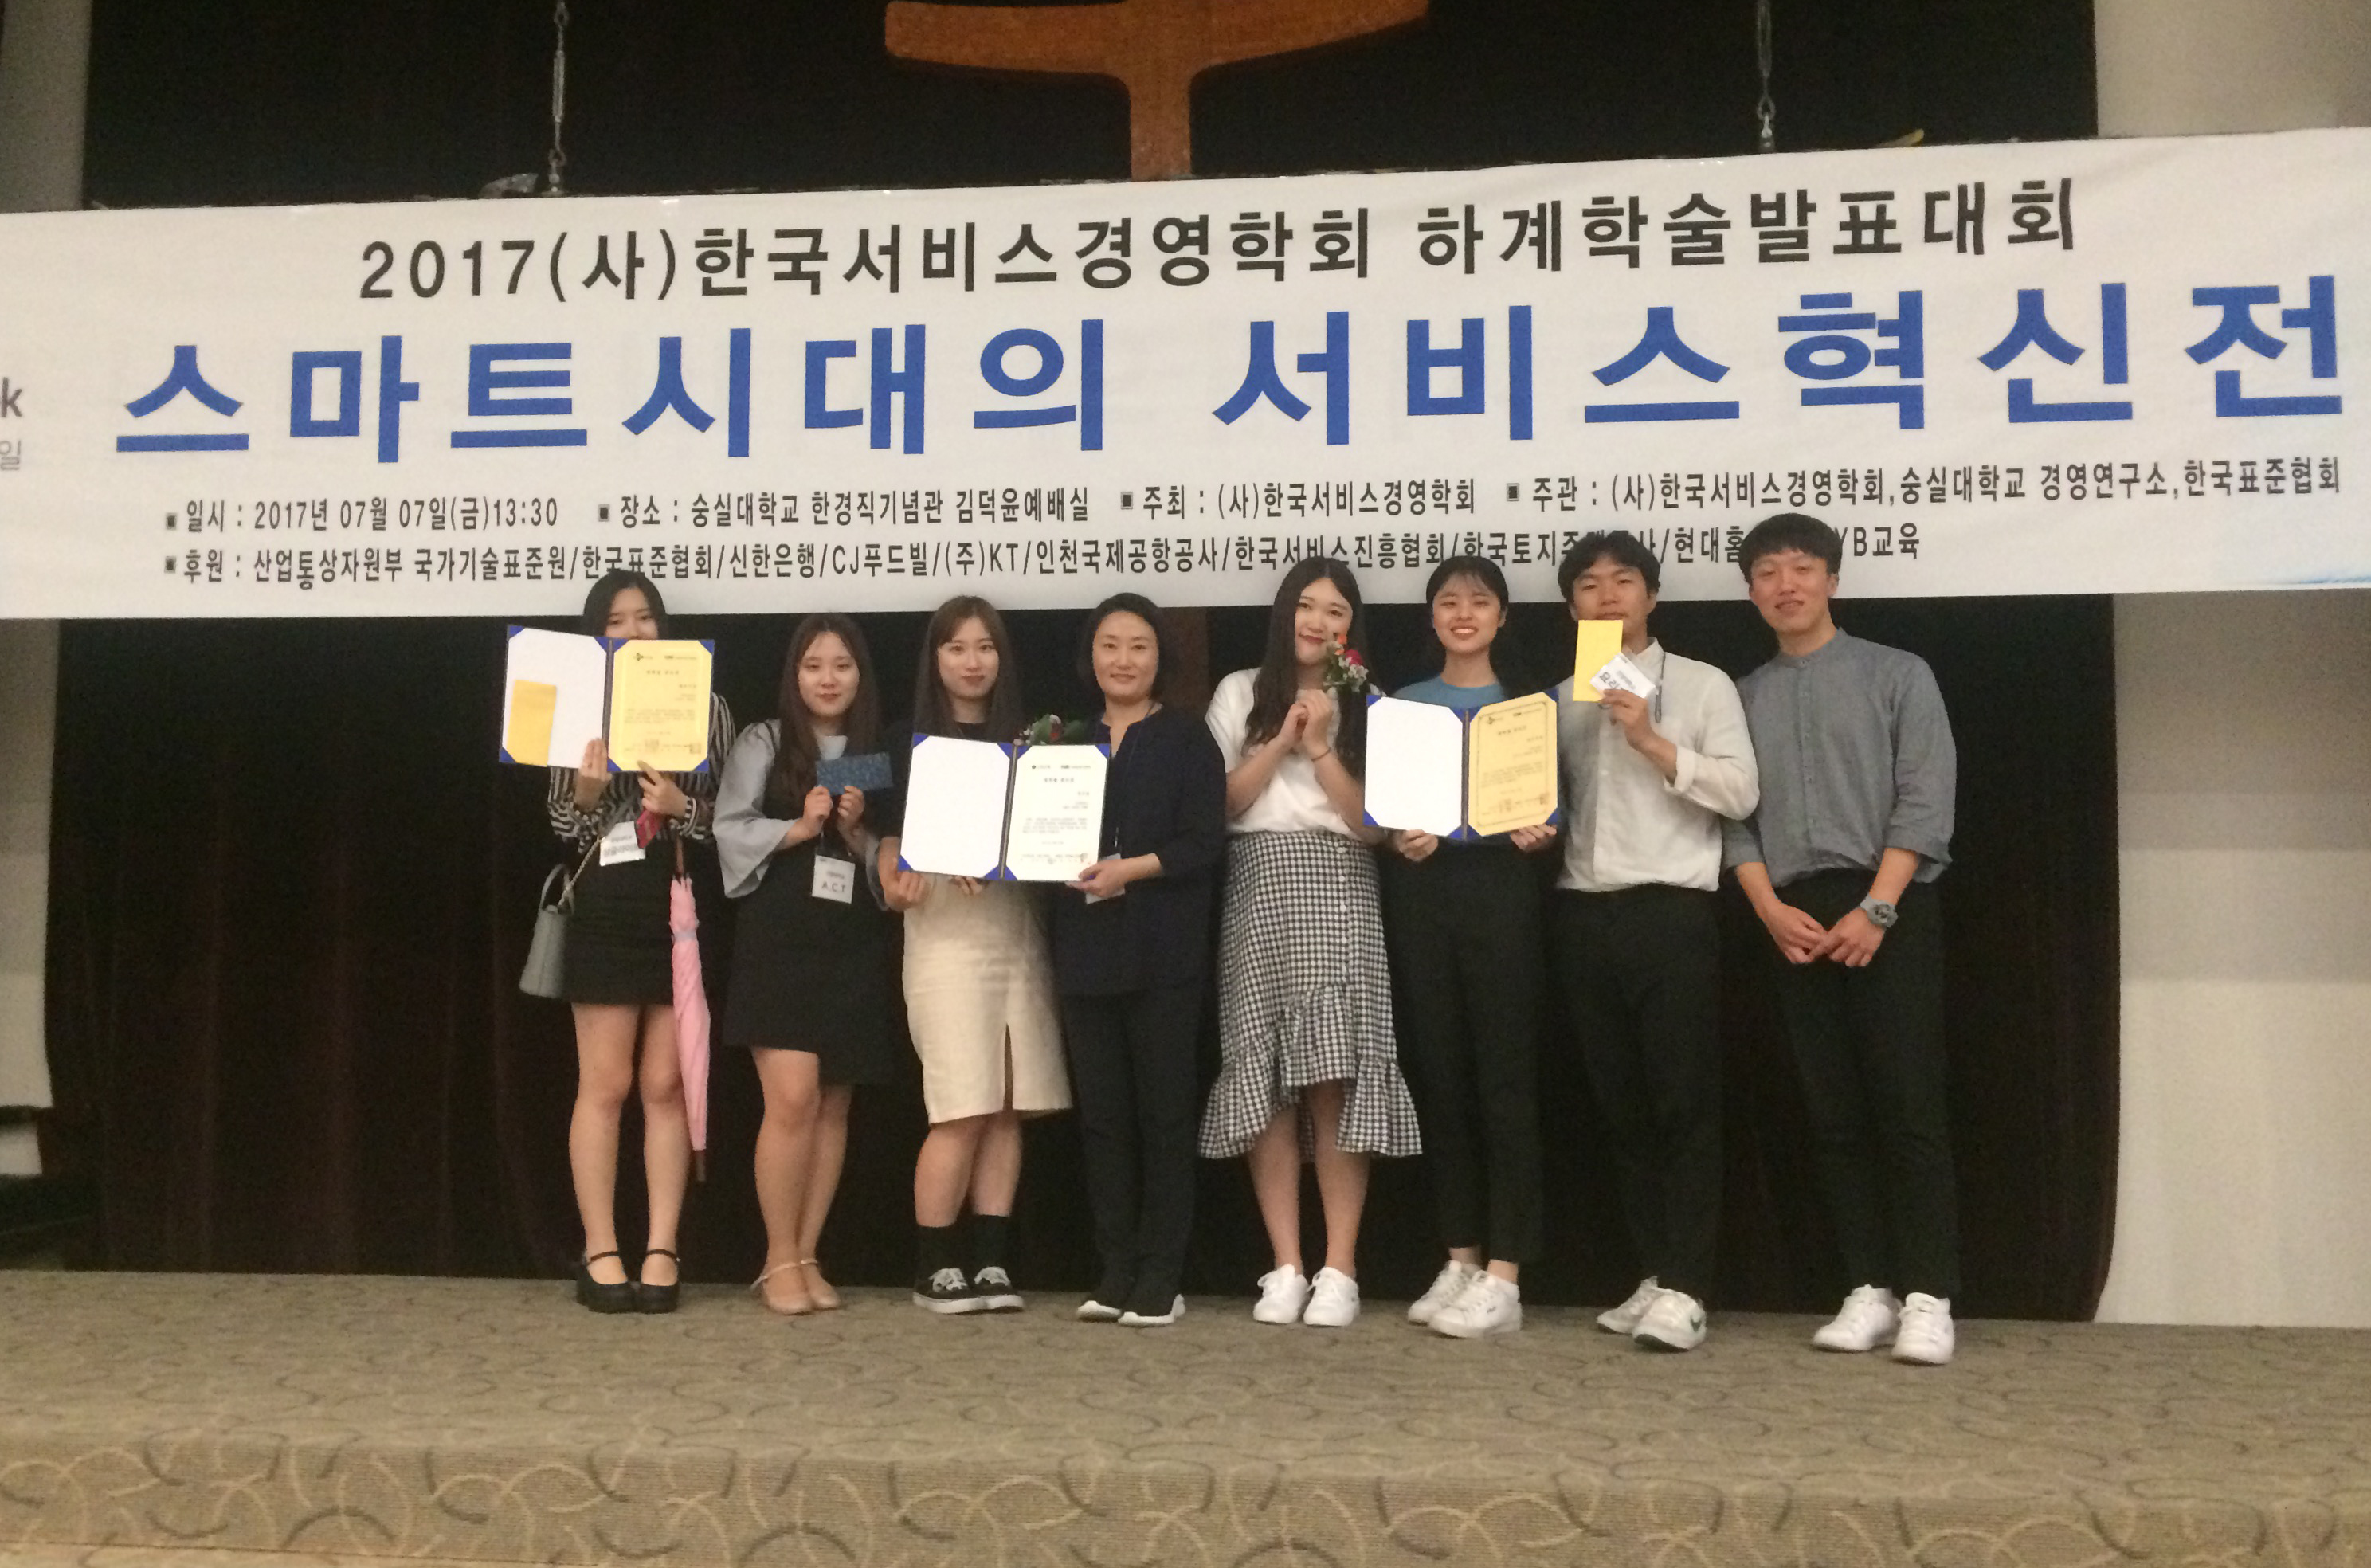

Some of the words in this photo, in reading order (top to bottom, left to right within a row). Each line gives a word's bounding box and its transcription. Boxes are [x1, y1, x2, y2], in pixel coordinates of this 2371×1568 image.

[360, 208, 1368, 303] 2017(사)한국서비스경영학회
[1417, 177, 2074, 275] 하계학술발표대회
[116, 319, 1103, 463] 스마트시대의
[254, 498, 328, 531] 2017년
[339, 496, 387, 531] 07월
[691, 492, 800, 528] 숭실대학교
[811, 489, 943, 526] 한경직기념관
[955, 486, 1088, 523] 김덕윤예배실
[1218, 478, 1475, 520] (사)한국서비스경영학회
[253, 547, 403, 590] 산업통상자원부
